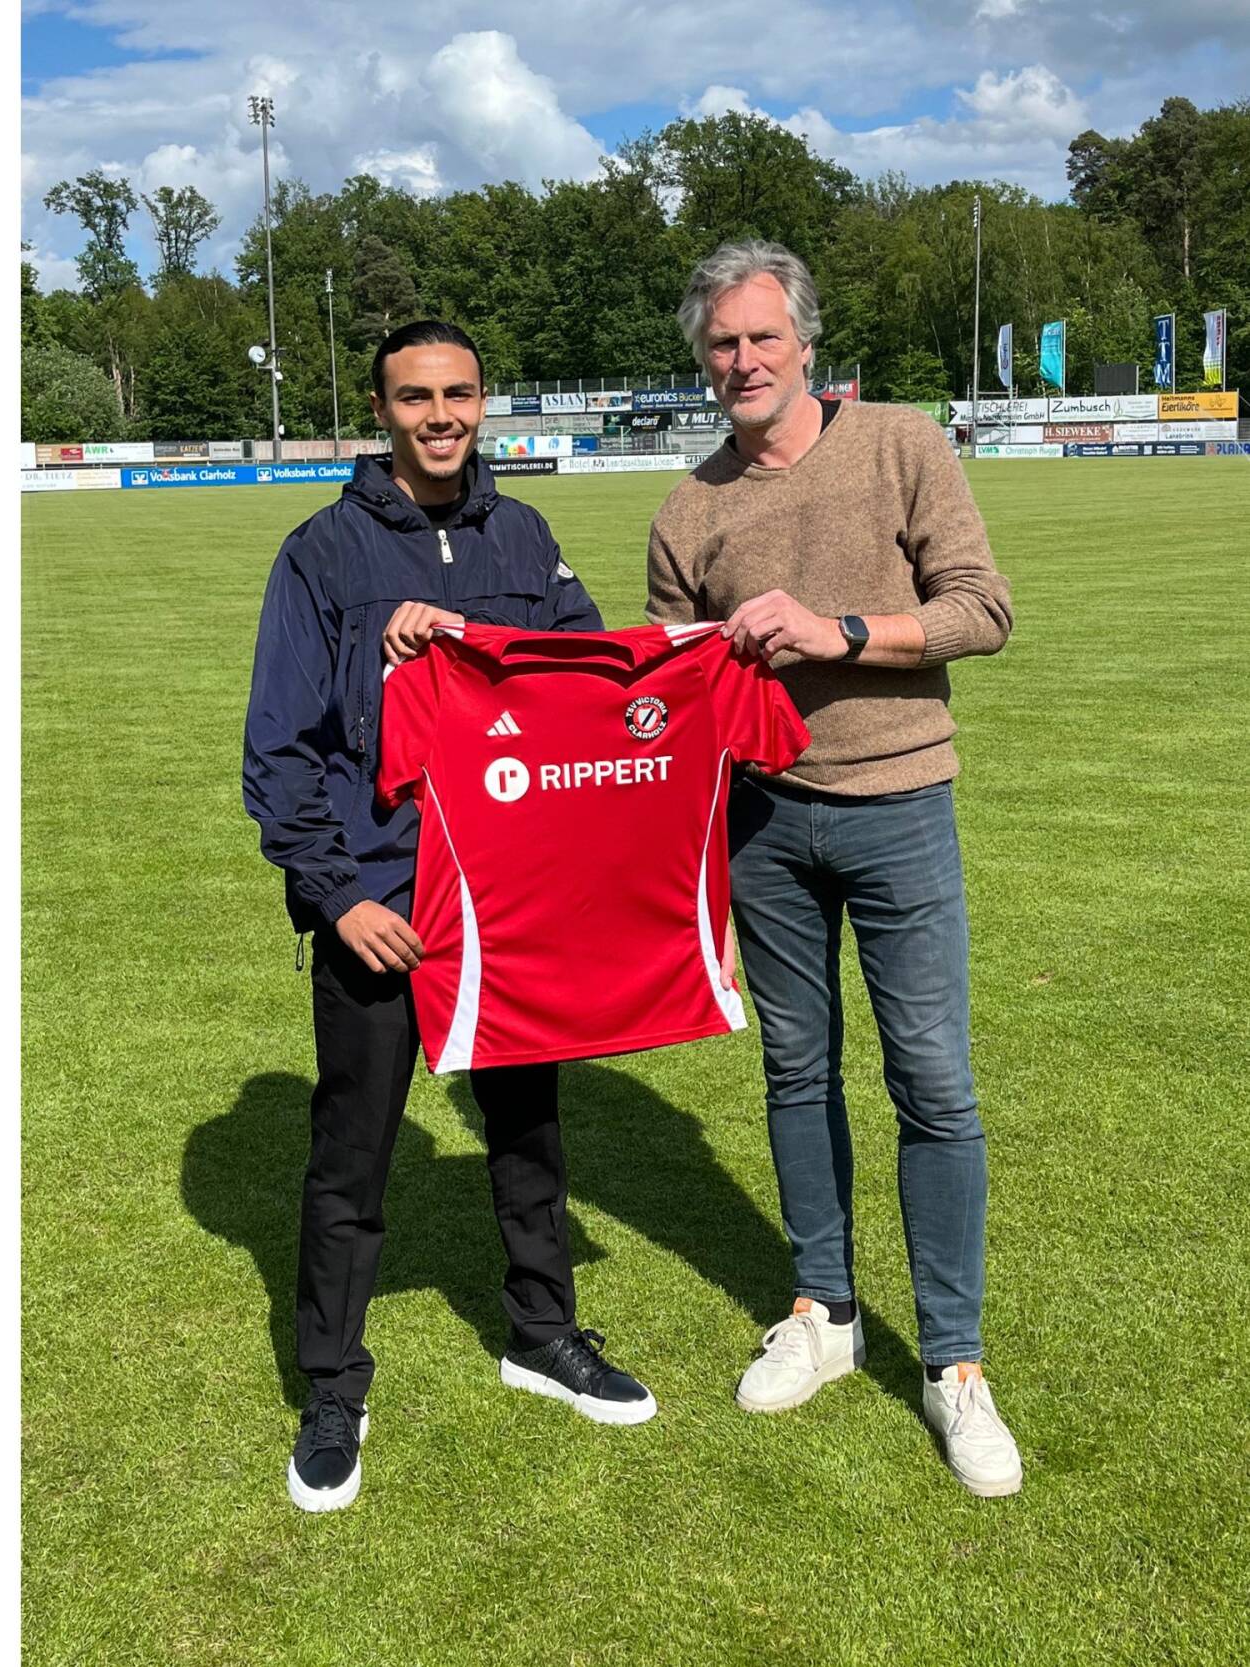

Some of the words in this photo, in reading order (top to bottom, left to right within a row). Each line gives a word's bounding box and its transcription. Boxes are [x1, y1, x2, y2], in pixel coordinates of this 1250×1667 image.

[544, 394, 583, 406] ASLAN
[640, 390, 678, 403] euronics
[1052, 400, 1110, 413] Zumbusch
[691, 412, 717, 424] MUT
[1055, 426, 1101, 436] SIEWEKE
[199, 469, 236, 480] Clarholz
[273, 467, 316, 478] Volksbank
[318, 466, 351, 477] Clarholz
[625, 702, 637, 717] TSV
[635, 696, 668, 715] VICTORIA
[628, 721, 667, 739] CLARHOLZ
[540, 755, 673, 791] RIPPERT
